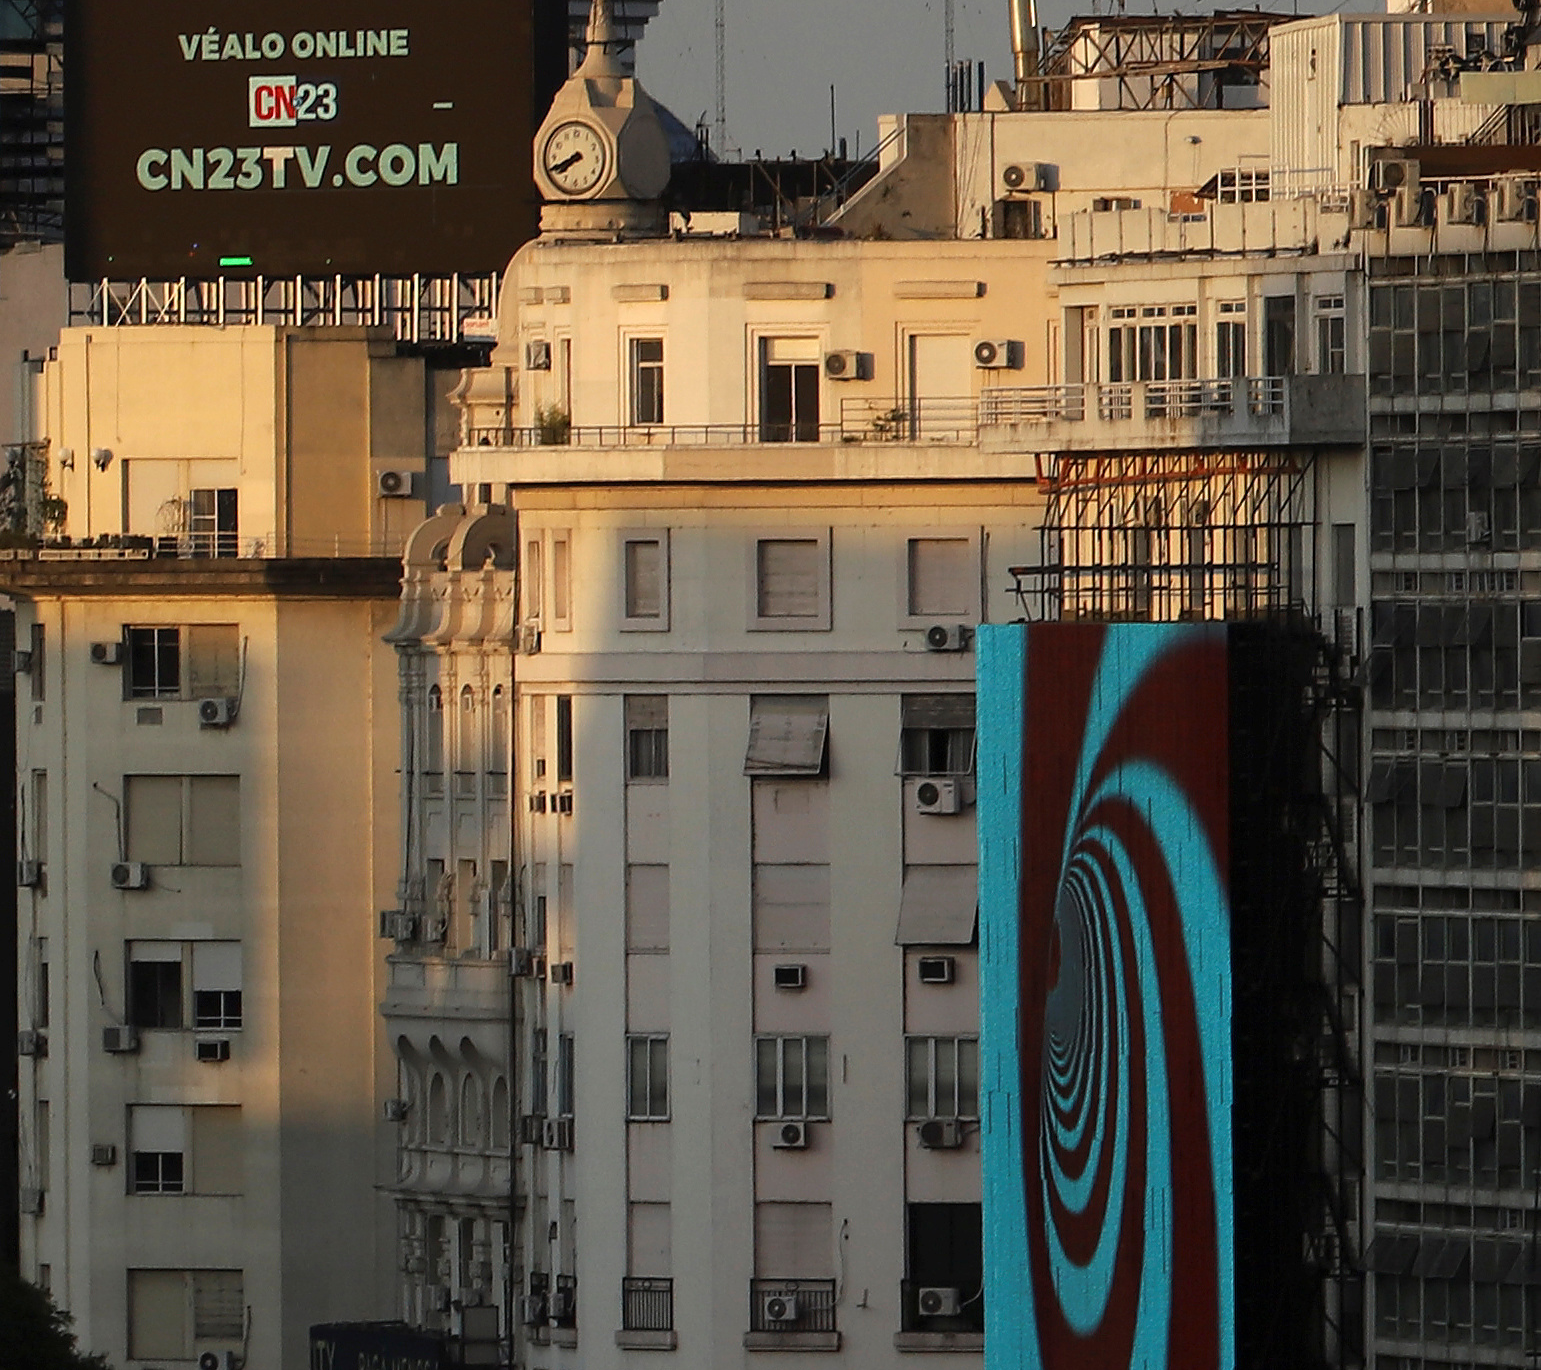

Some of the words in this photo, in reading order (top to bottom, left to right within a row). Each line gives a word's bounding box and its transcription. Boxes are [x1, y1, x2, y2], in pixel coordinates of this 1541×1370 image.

[178, 26, 285, 62] VÉALO
[291, 28, 410, 61] ONLINE
[254, 81, 339, 121] CN23
[136, 141, 460, 191] CN23TV.COM
